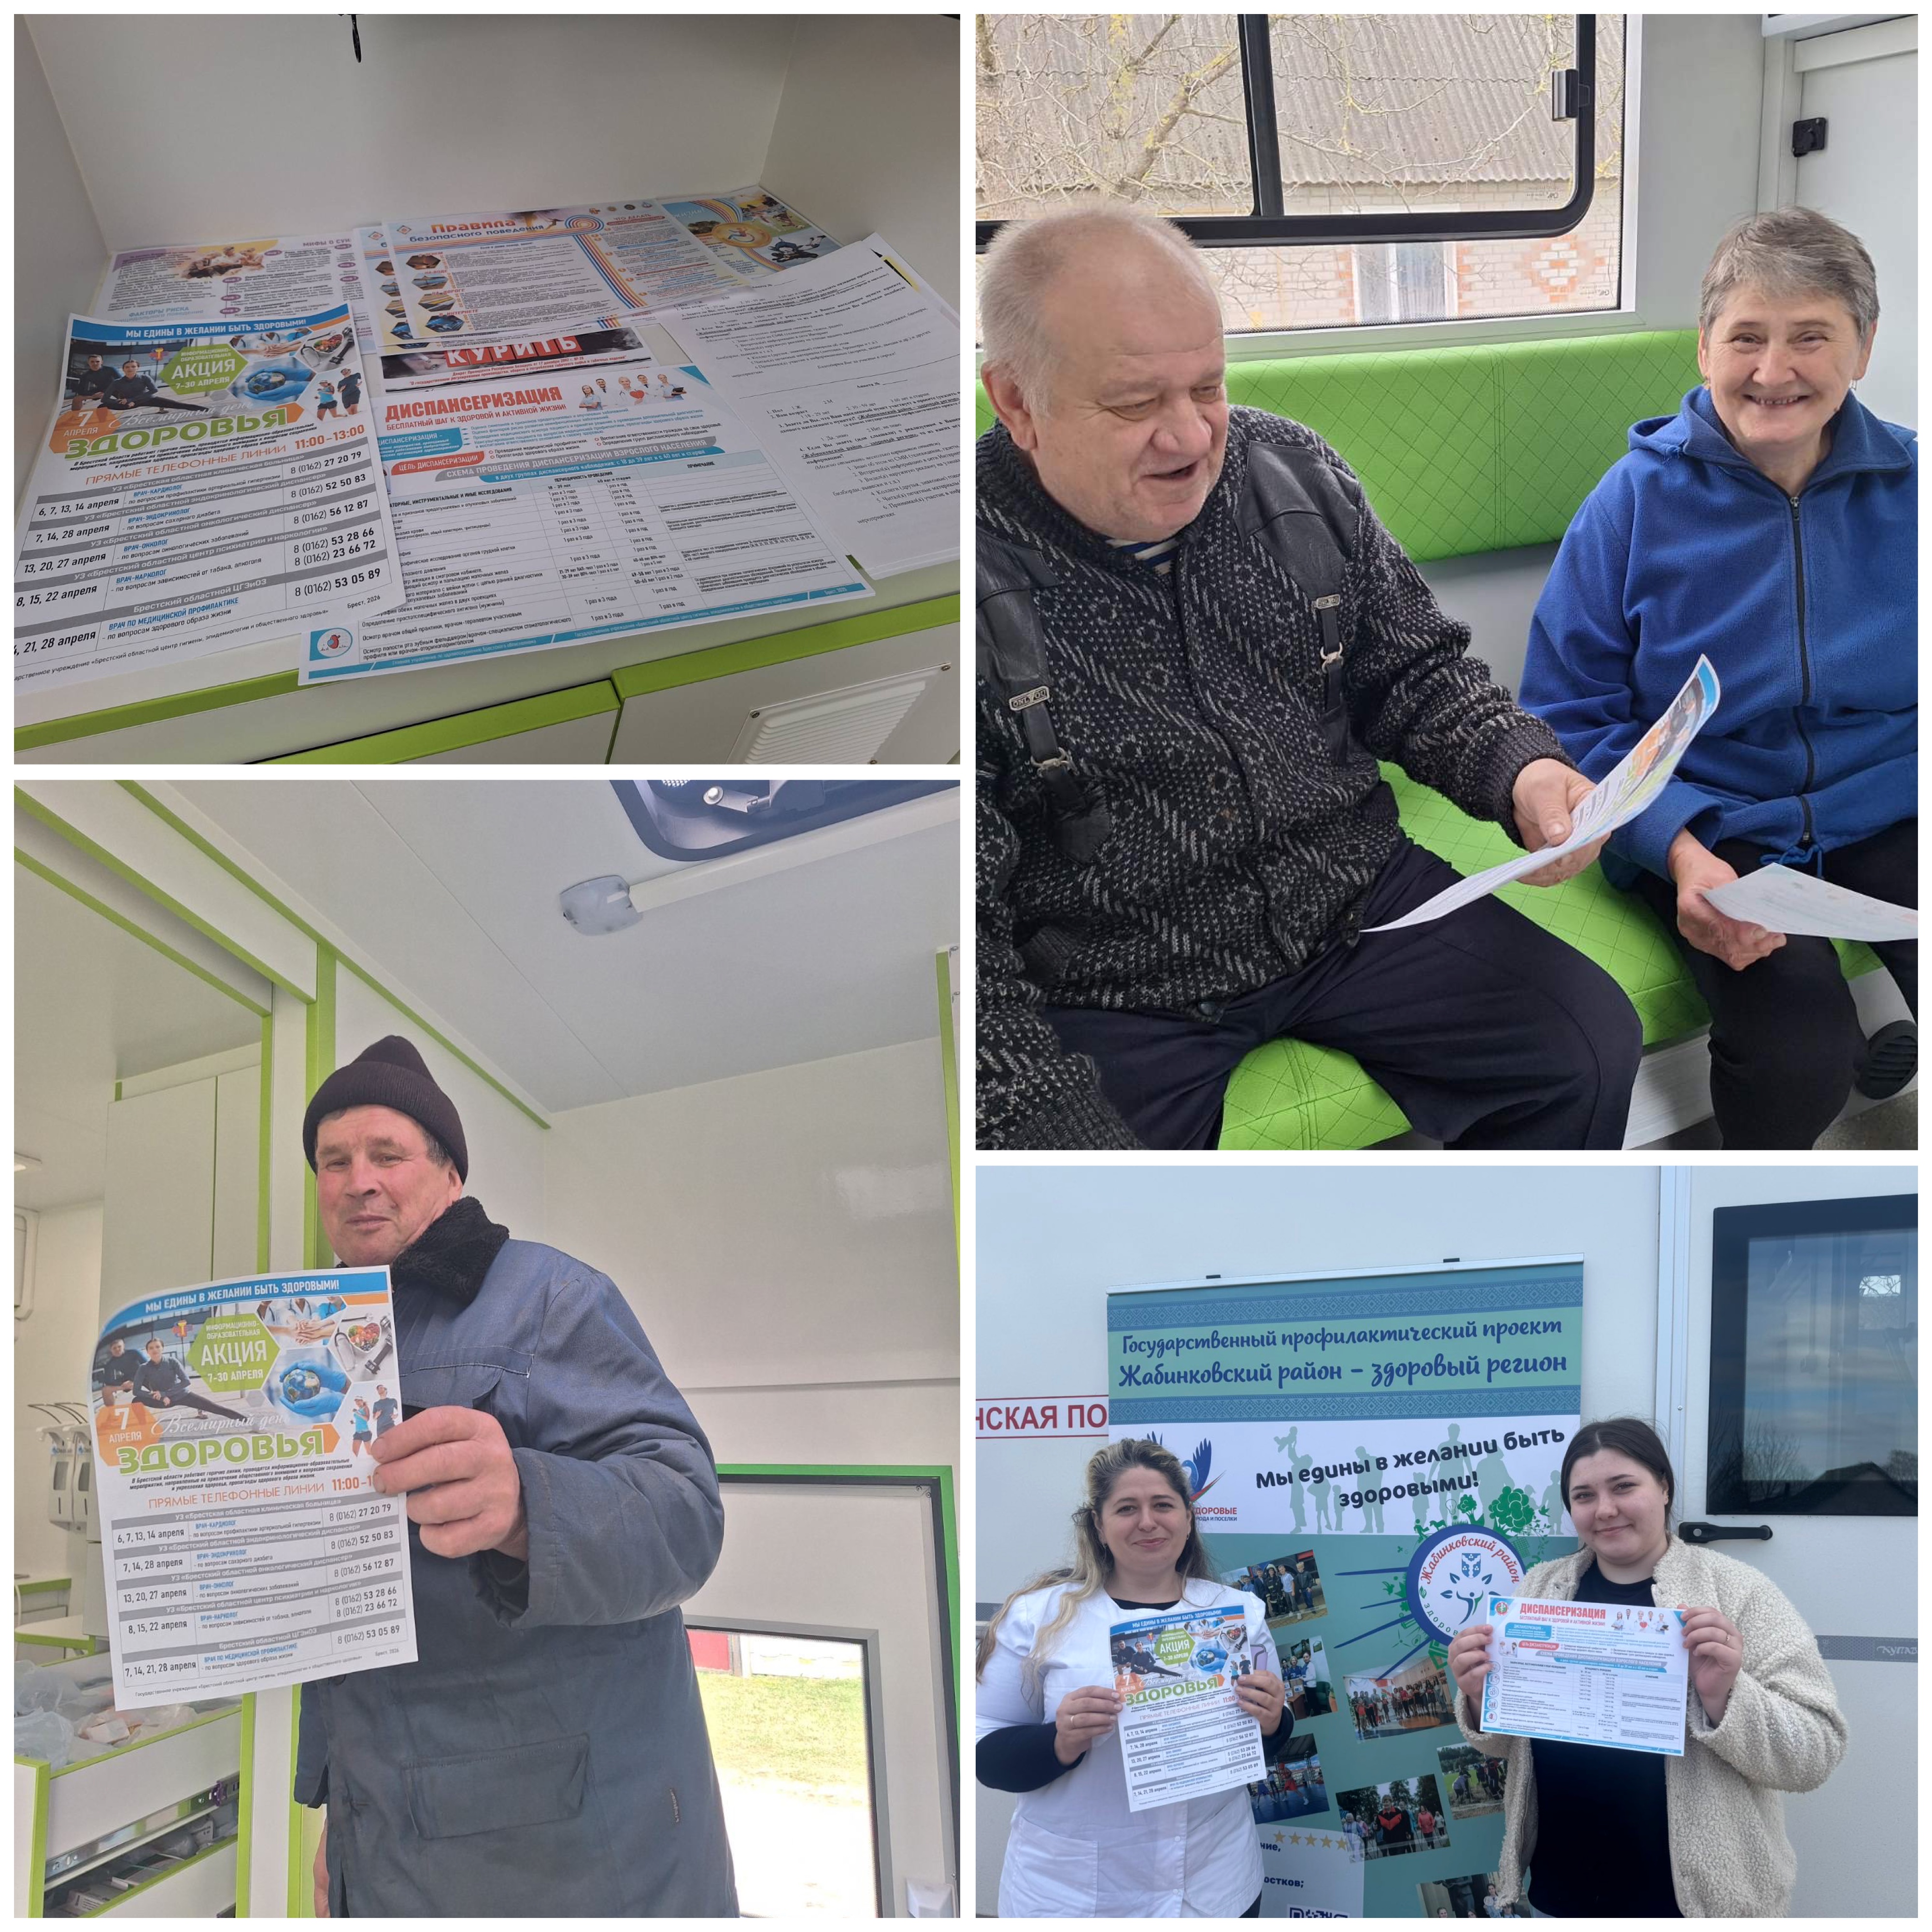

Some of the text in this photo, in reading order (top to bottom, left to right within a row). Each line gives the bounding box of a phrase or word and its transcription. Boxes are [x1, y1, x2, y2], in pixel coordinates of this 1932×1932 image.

[410, 224, 544, 242] безопасного поведения
[431, 219, 515, 233] Правила
[126, 329, 141, 338] МЫ
[144, 328, 174, 337] ЕДИНЫ
[185, 325, 226, 335] ЖЕЛАНИИ
[254, 320, 306, 330] ЗДОРОВЫМИ!
[181, 348, 231, 356] ИНФОРМАЦИОННО-
[181, 353, 231, 362] ОБРАЗОВАТЕЛЬНАЯ
[447, 339, 578, 364] КУРИТЬ
[171, 359, 235, 380] АКЦИЯ
[198, 377, 229, 386] АПРЕЛЯ
[385, 386, 562, 423] ДИСПАНСЕРИЗАЦИЯ
[78, 412, 93, 426] 7
[109, 407, 215, 428] Всемирный
[387, 418, 432, 431] БЕСПЛАТНЫЙ
[435, 417, 448, 425] ШАГ
[457, 411, 493, 422] ЗДОРОВОЙ
[502, 407, 537, 418] АКТИВНОЙ
[540, 403, 567, 412] ЖИЗНИ!
[64, 427, 98, 437] АПРЕЛЯ
[64, 409, 286, 459] ЗДОРОВЬЯ
[85, 469, 141, 485] ПРЯМЫЕ
[147, 455, 237, 474] ТЕЛЕФОННЫЕ
[241, 445, 285, 459] ЛИНИИ
[298, 462, 321, 473] (0162)
[324, 458, 334, 467] 27
[338, 455, 348, 464] 20
[351, 451, 361, 460] 79
[399, 455, 478, 471] ЦЕЛЬ ДИСПАНСЕРИЗАЦИИ
[447, 440, 707, 477] СХЕМА ПРОВЕДЕНИЯ ДИСПАНСЕРИЗАЦИИ ВЗРОСЛОГО НАСЕЛЕНИЯ
[133, 484, 182, 497] ВРАЧ-КАРДИОЛОГ
[299, 485, 323, 497] (0162)
[341, 478, 351, 486] 50
[355, 474, 366, 483] 83
[39, 508, 45, 516] 6,
[51, 507, 57, 515] 7,
[61, 505, 71, 513] 13,
[87, 498, 119, 511] апреля
[128, 508, 190, 523] ВРАЧ-ЭНДОКРИНОЛОГ
[36, 524, 109, 543] 7, 14, 28 апреля
[303, 539, 328, 552] (0162)
[332, 536, 343, 545] 53
[347, 532, 358, 541] 28
[363, 528, 374, 537] 66
[124, 539, 169, 551] ВРАЧ-ОНКОЛОГ
[25, 553, 105, 573] 13, 20, 27 апреля
[116, 569, 167, 583] ВРАЧ-НАРКОЛОГ
[295, 568, 380, 596] 8 (0162) 53 05 89
[16, 586, 97, 607] 8, 15, 22 апреля
[133, 597, 182, 612] Брестский
[184, 585, 231, 602] областной
[367, 595, 380, 604] 2026
[109, 622, 125, 630] ВРАЧ
[138, 609, 186, 625] МЕДИЦИНСКОЙ
[188, 597, 239, 615] ПРОФИЛАКТИКЕ
[383, 630, 400, 639] врачом
[419, 624, 443, 633] практики,
[444, 616, 492, 628] врачом-терапевтом
[494, 612, 522, 621] участковым
[24, 632, 96, 653] 21, 28 апреля
[146, 1279, 340, 1313] МЫ ЕДИНЫ В ЖЕЛАНИИ БЫТЬ ЗДОРОВЫМИ!
[1122, 1320, 1562, 1358] Государственный профилактический проект
[200, 1340, 267, 1366] АКЦИЯ
[208, 1369, 264, 1382] 7-30 АПРЕЛЯ
[1119, 1361, 1273, 1387] Жабинковский
[1279, 1361, 1342, 1389] район
[1371, 1354, 1480, 1387] здоровый
[1487, 1354, 1566, 1382] регион
[114, 1408, 129, 1430] 7
[1068, 1404, 1108, 1428] ПО
[109, 1431, 142, 1443] АПРЕЛЯ
[118, 1431, 323, 1474] ЗДОРОВЬЯ
[1256, 1428, 1564, 1489] Мы едины в желании быть
[149, 1483, 324, 1508] ПРЯМЫЕ ТЕЛЕФОННЫЕ ЛИНИИ
[1339, 1471, 1479, 1508] здоровыми!
[1421, 1536, 1520, 1584] Жабинковский район
[1194, 1610, 1222, 1618] ЗДОРОВЫМИ!
[1520, 1603, 1606, 1619] ДИСПАНСЕРИЗАЦИЯ
[128, 1621, 187, 1634] 8, 15, 22 апреля
[1160, 1639, 1189, 1653] АКЦИЯ
[1122, 1675, 1129, 1686] 7
[1125, 1676, 1219, 1706] ЗДОРОВЬЯ
[1140, 1711, 1163, 1720] ПРЯМЫЕ
[1164, 1704, 1201, 1715] ТЕЛЕФОННЫЕ
